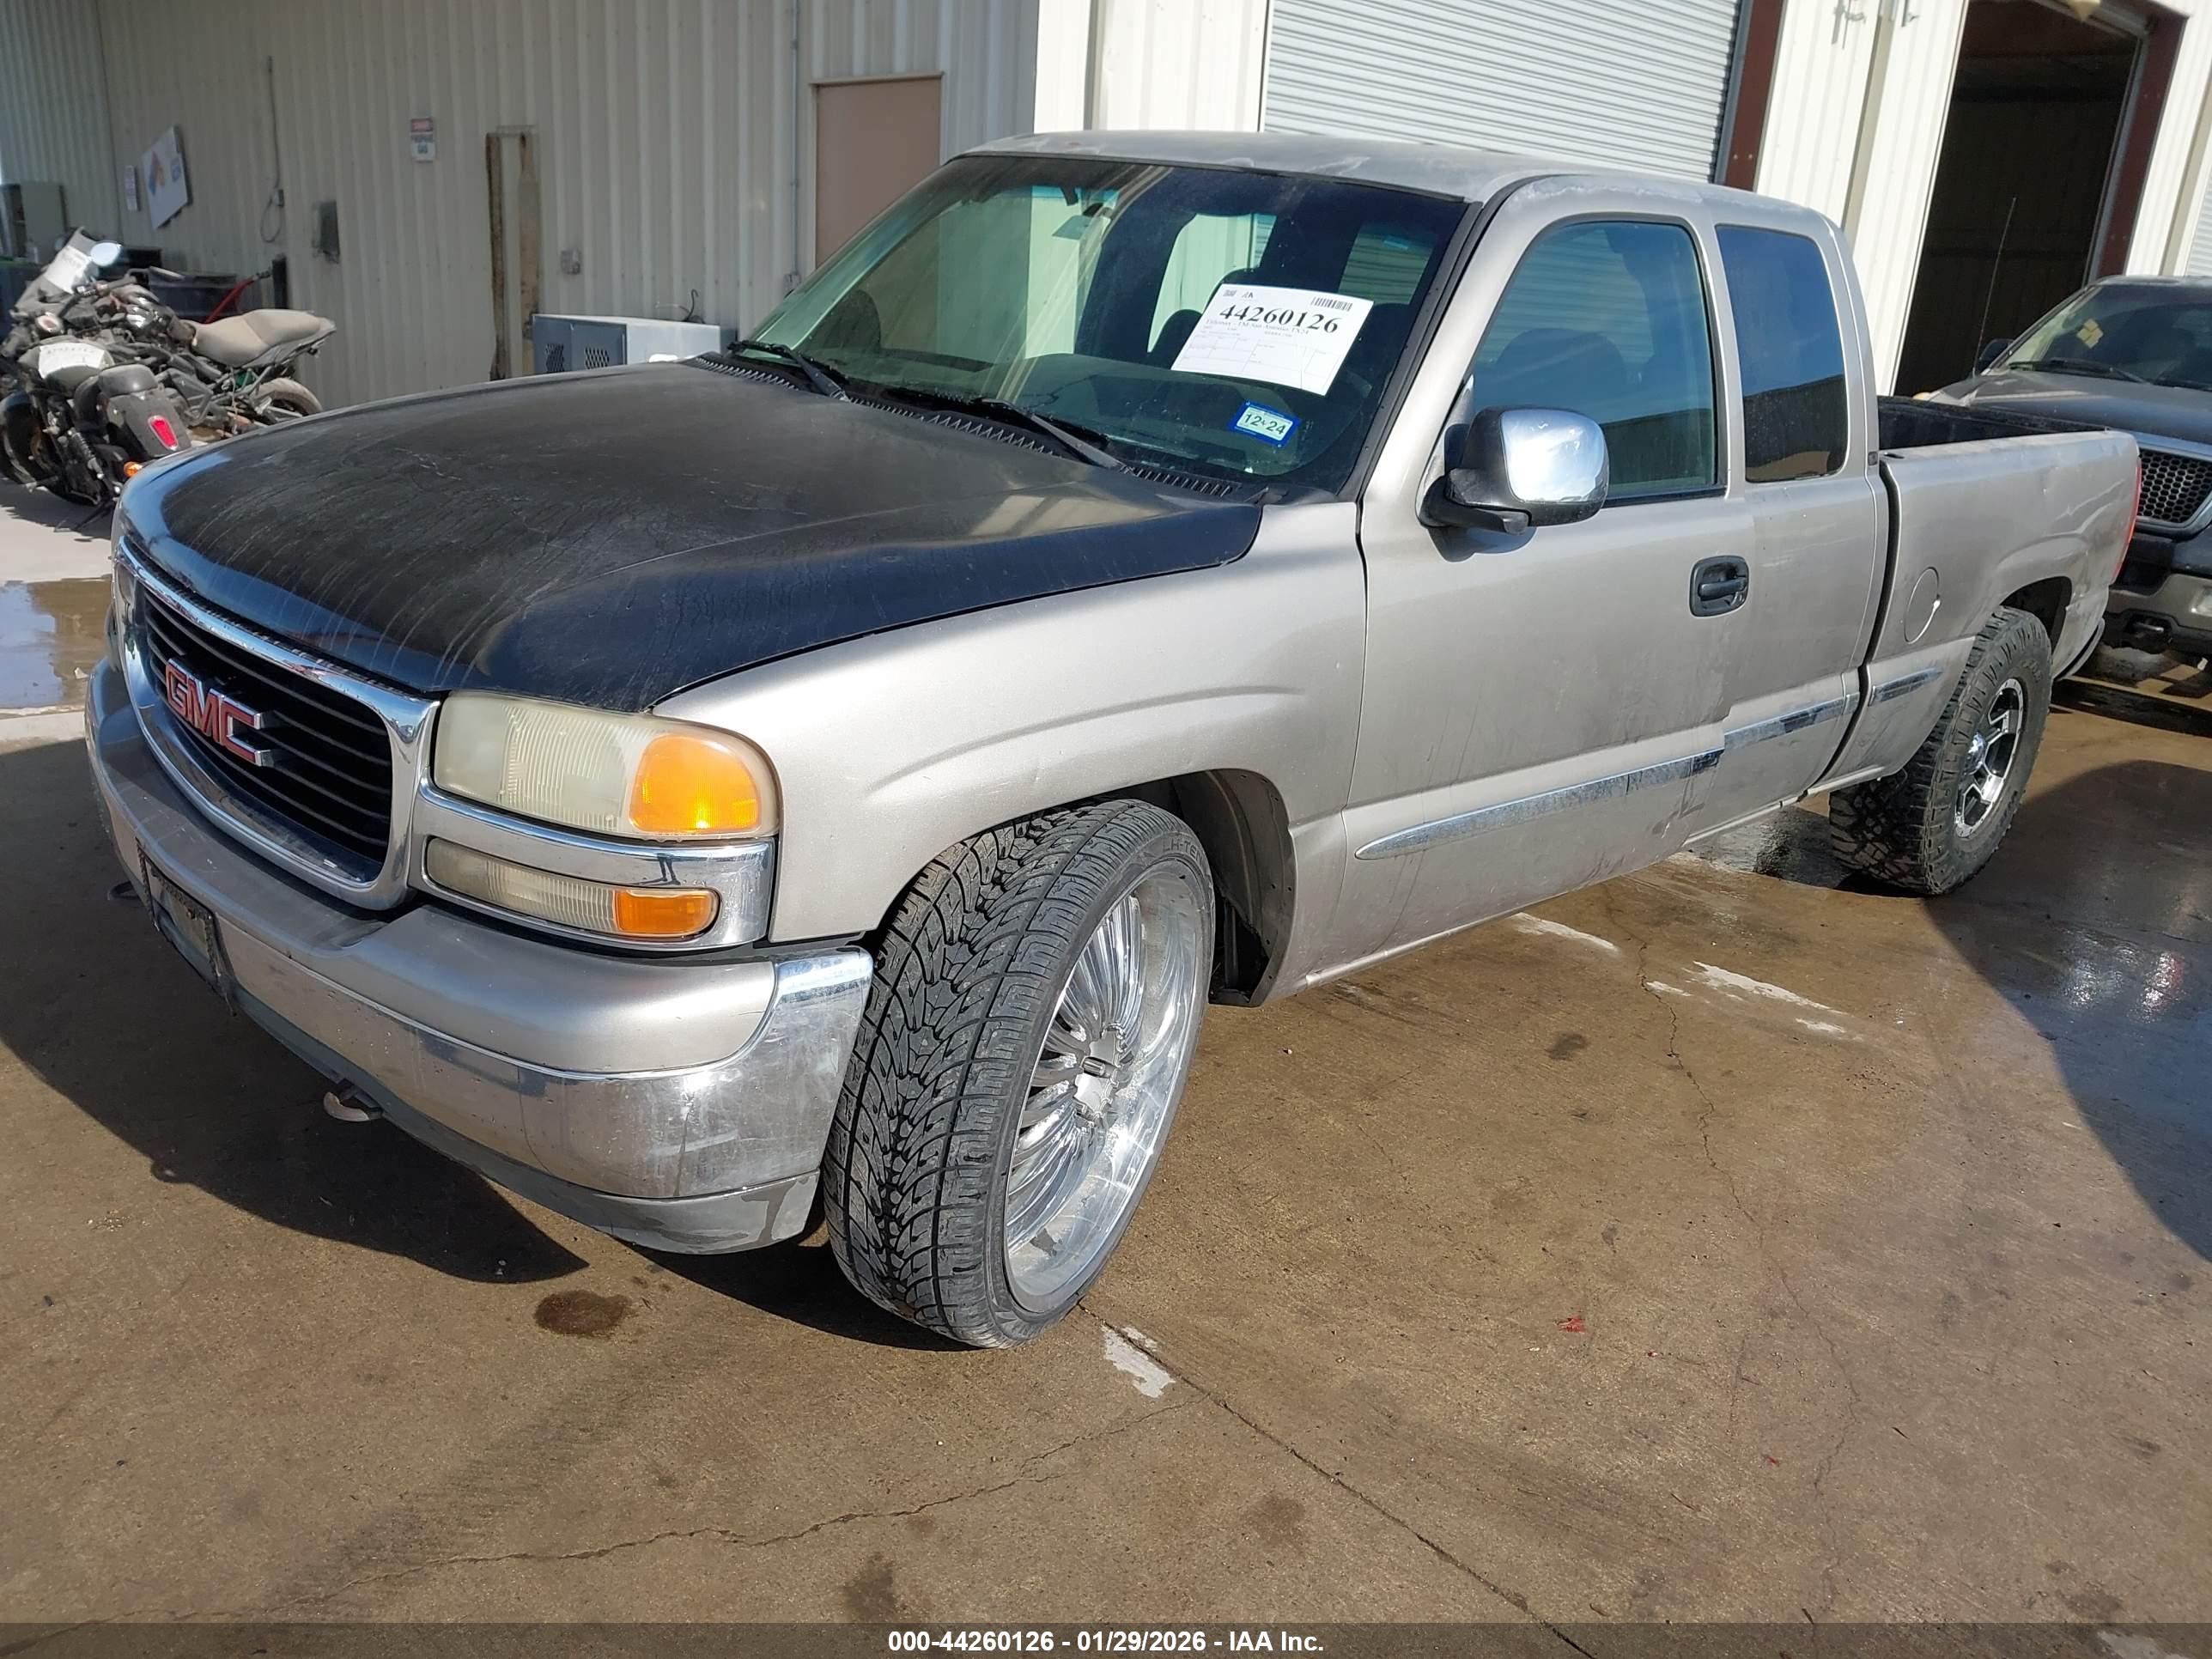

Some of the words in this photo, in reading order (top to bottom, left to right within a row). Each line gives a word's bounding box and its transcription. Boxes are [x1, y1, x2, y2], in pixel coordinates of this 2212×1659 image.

[1219, 304, 1342, 333] 44260126
[1245, 413, 1262, 427] 12
[1266, 421, 1285, 434] 24
[165, 658, 262, 767] GMC
